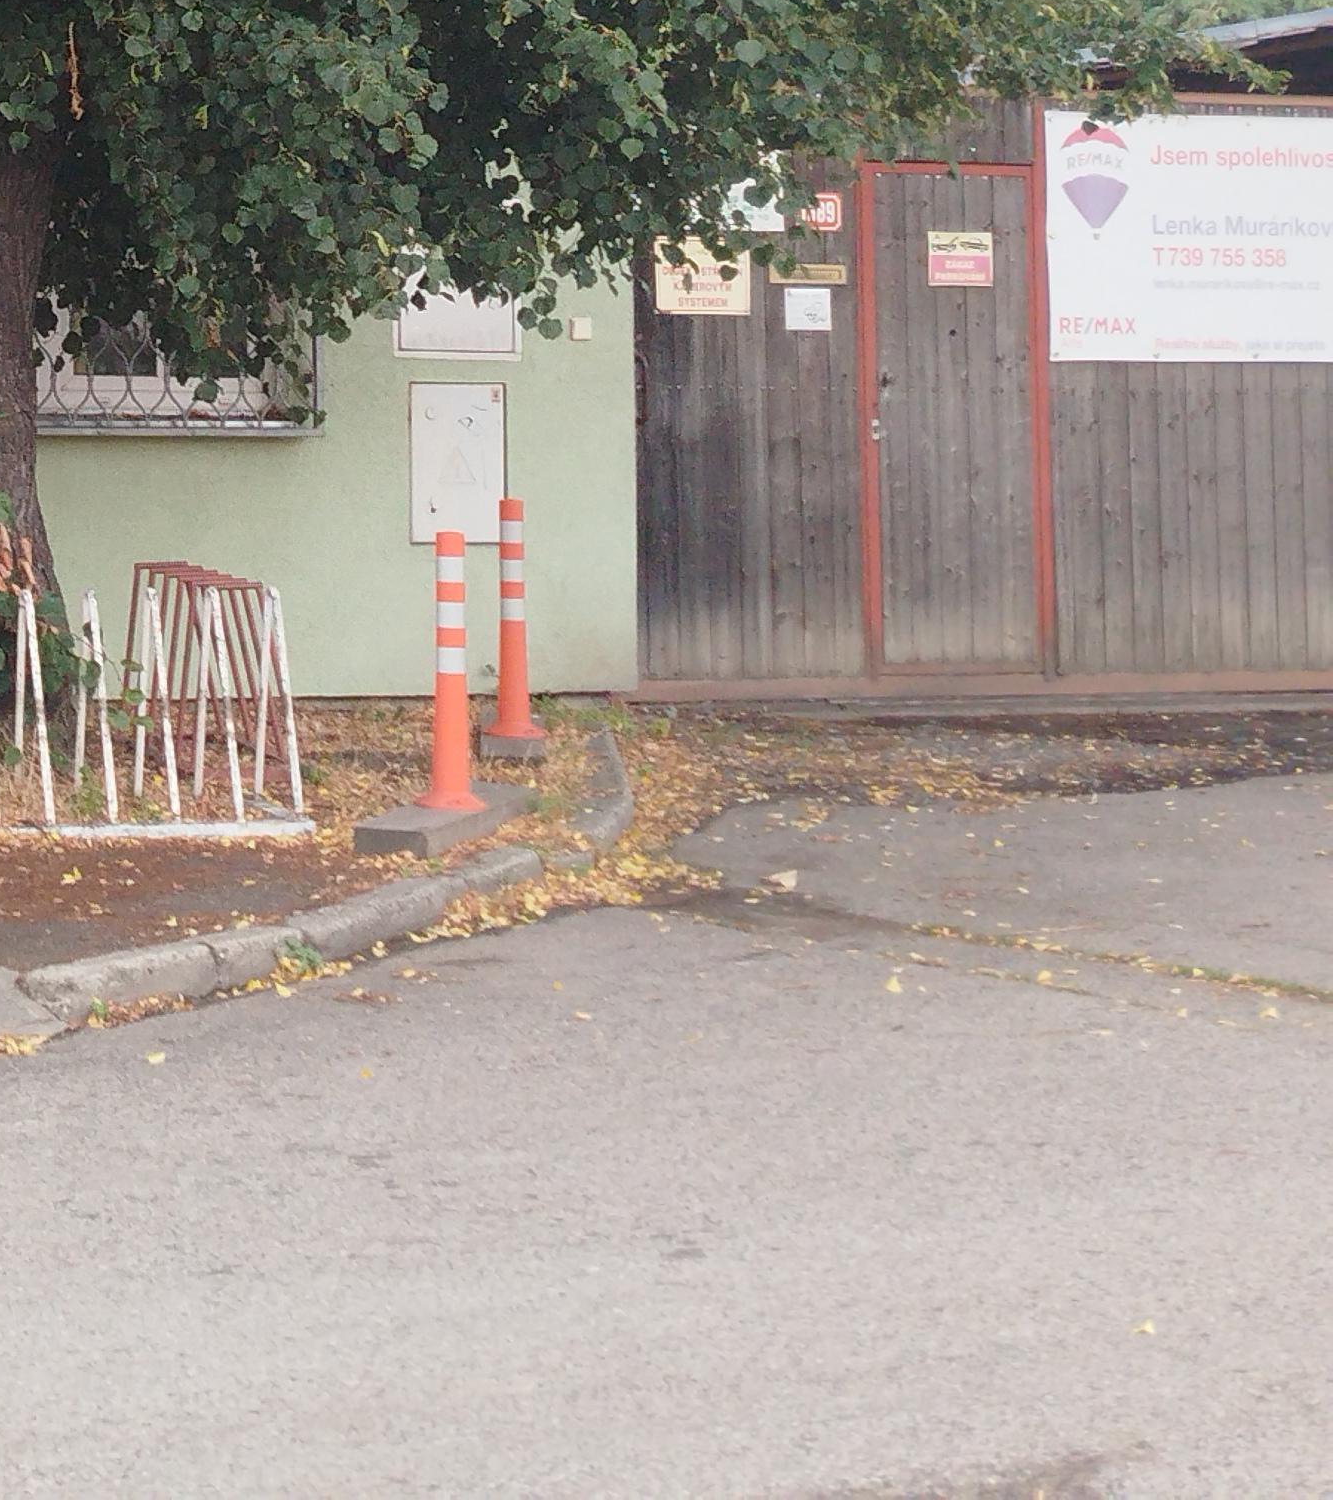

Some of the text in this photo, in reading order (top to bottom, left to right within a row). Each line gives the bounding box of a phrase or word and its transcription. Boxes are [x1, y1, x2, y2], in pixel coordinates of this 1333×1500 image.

[1066, 152, 1124, 170] RE/MAX
[1149, 145, 1208, 165] Jsem
[1152, 214, 1217, 236] Lenka
[1169, 247, 1203, 267] 739
[1211, 248, 1246, 267] 755
[1252, 248, 1287, 268] 358
[1059, 316, 1136, 334] RE/MAX
